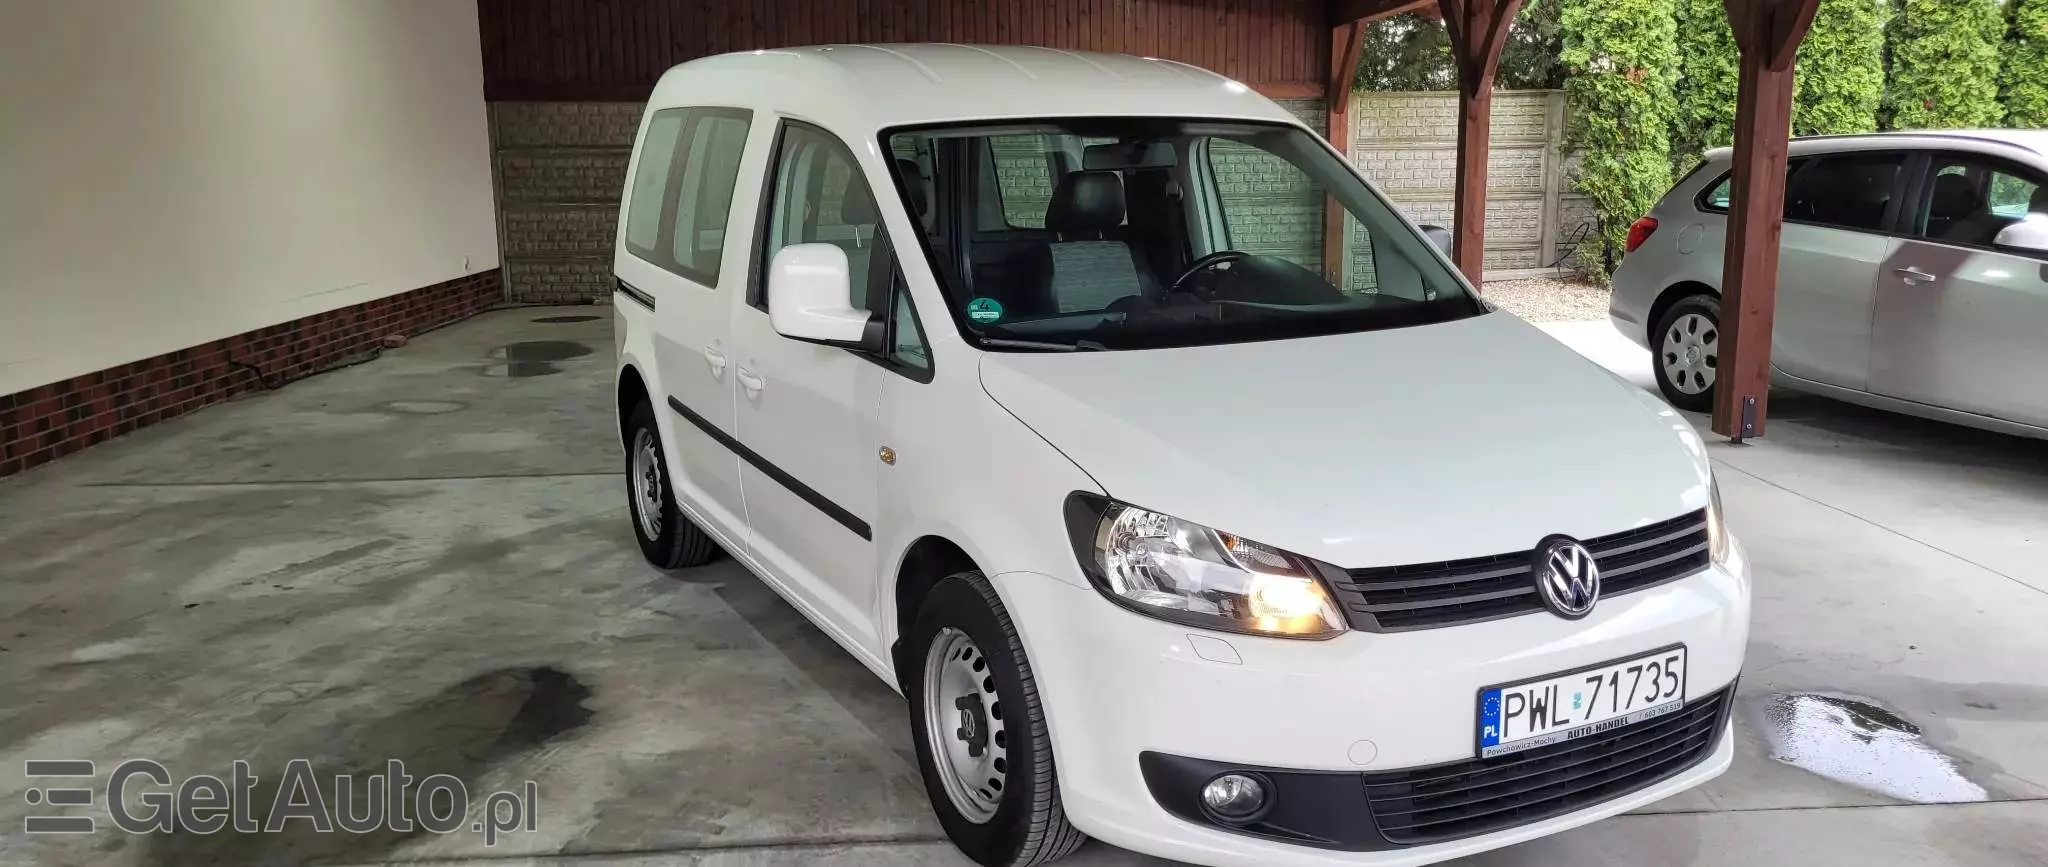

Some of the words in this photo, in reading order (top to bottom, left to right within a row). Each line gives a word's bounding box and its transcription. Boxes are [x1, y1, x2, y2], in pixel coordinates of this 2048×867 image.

[1503, 684, 1570, 738] PWL
[1584, 656, 1680, 719] 71735
[1483, 726, 1498, 738] PL
[1567, 716, 1629, 739] AUTO-HANDEL
